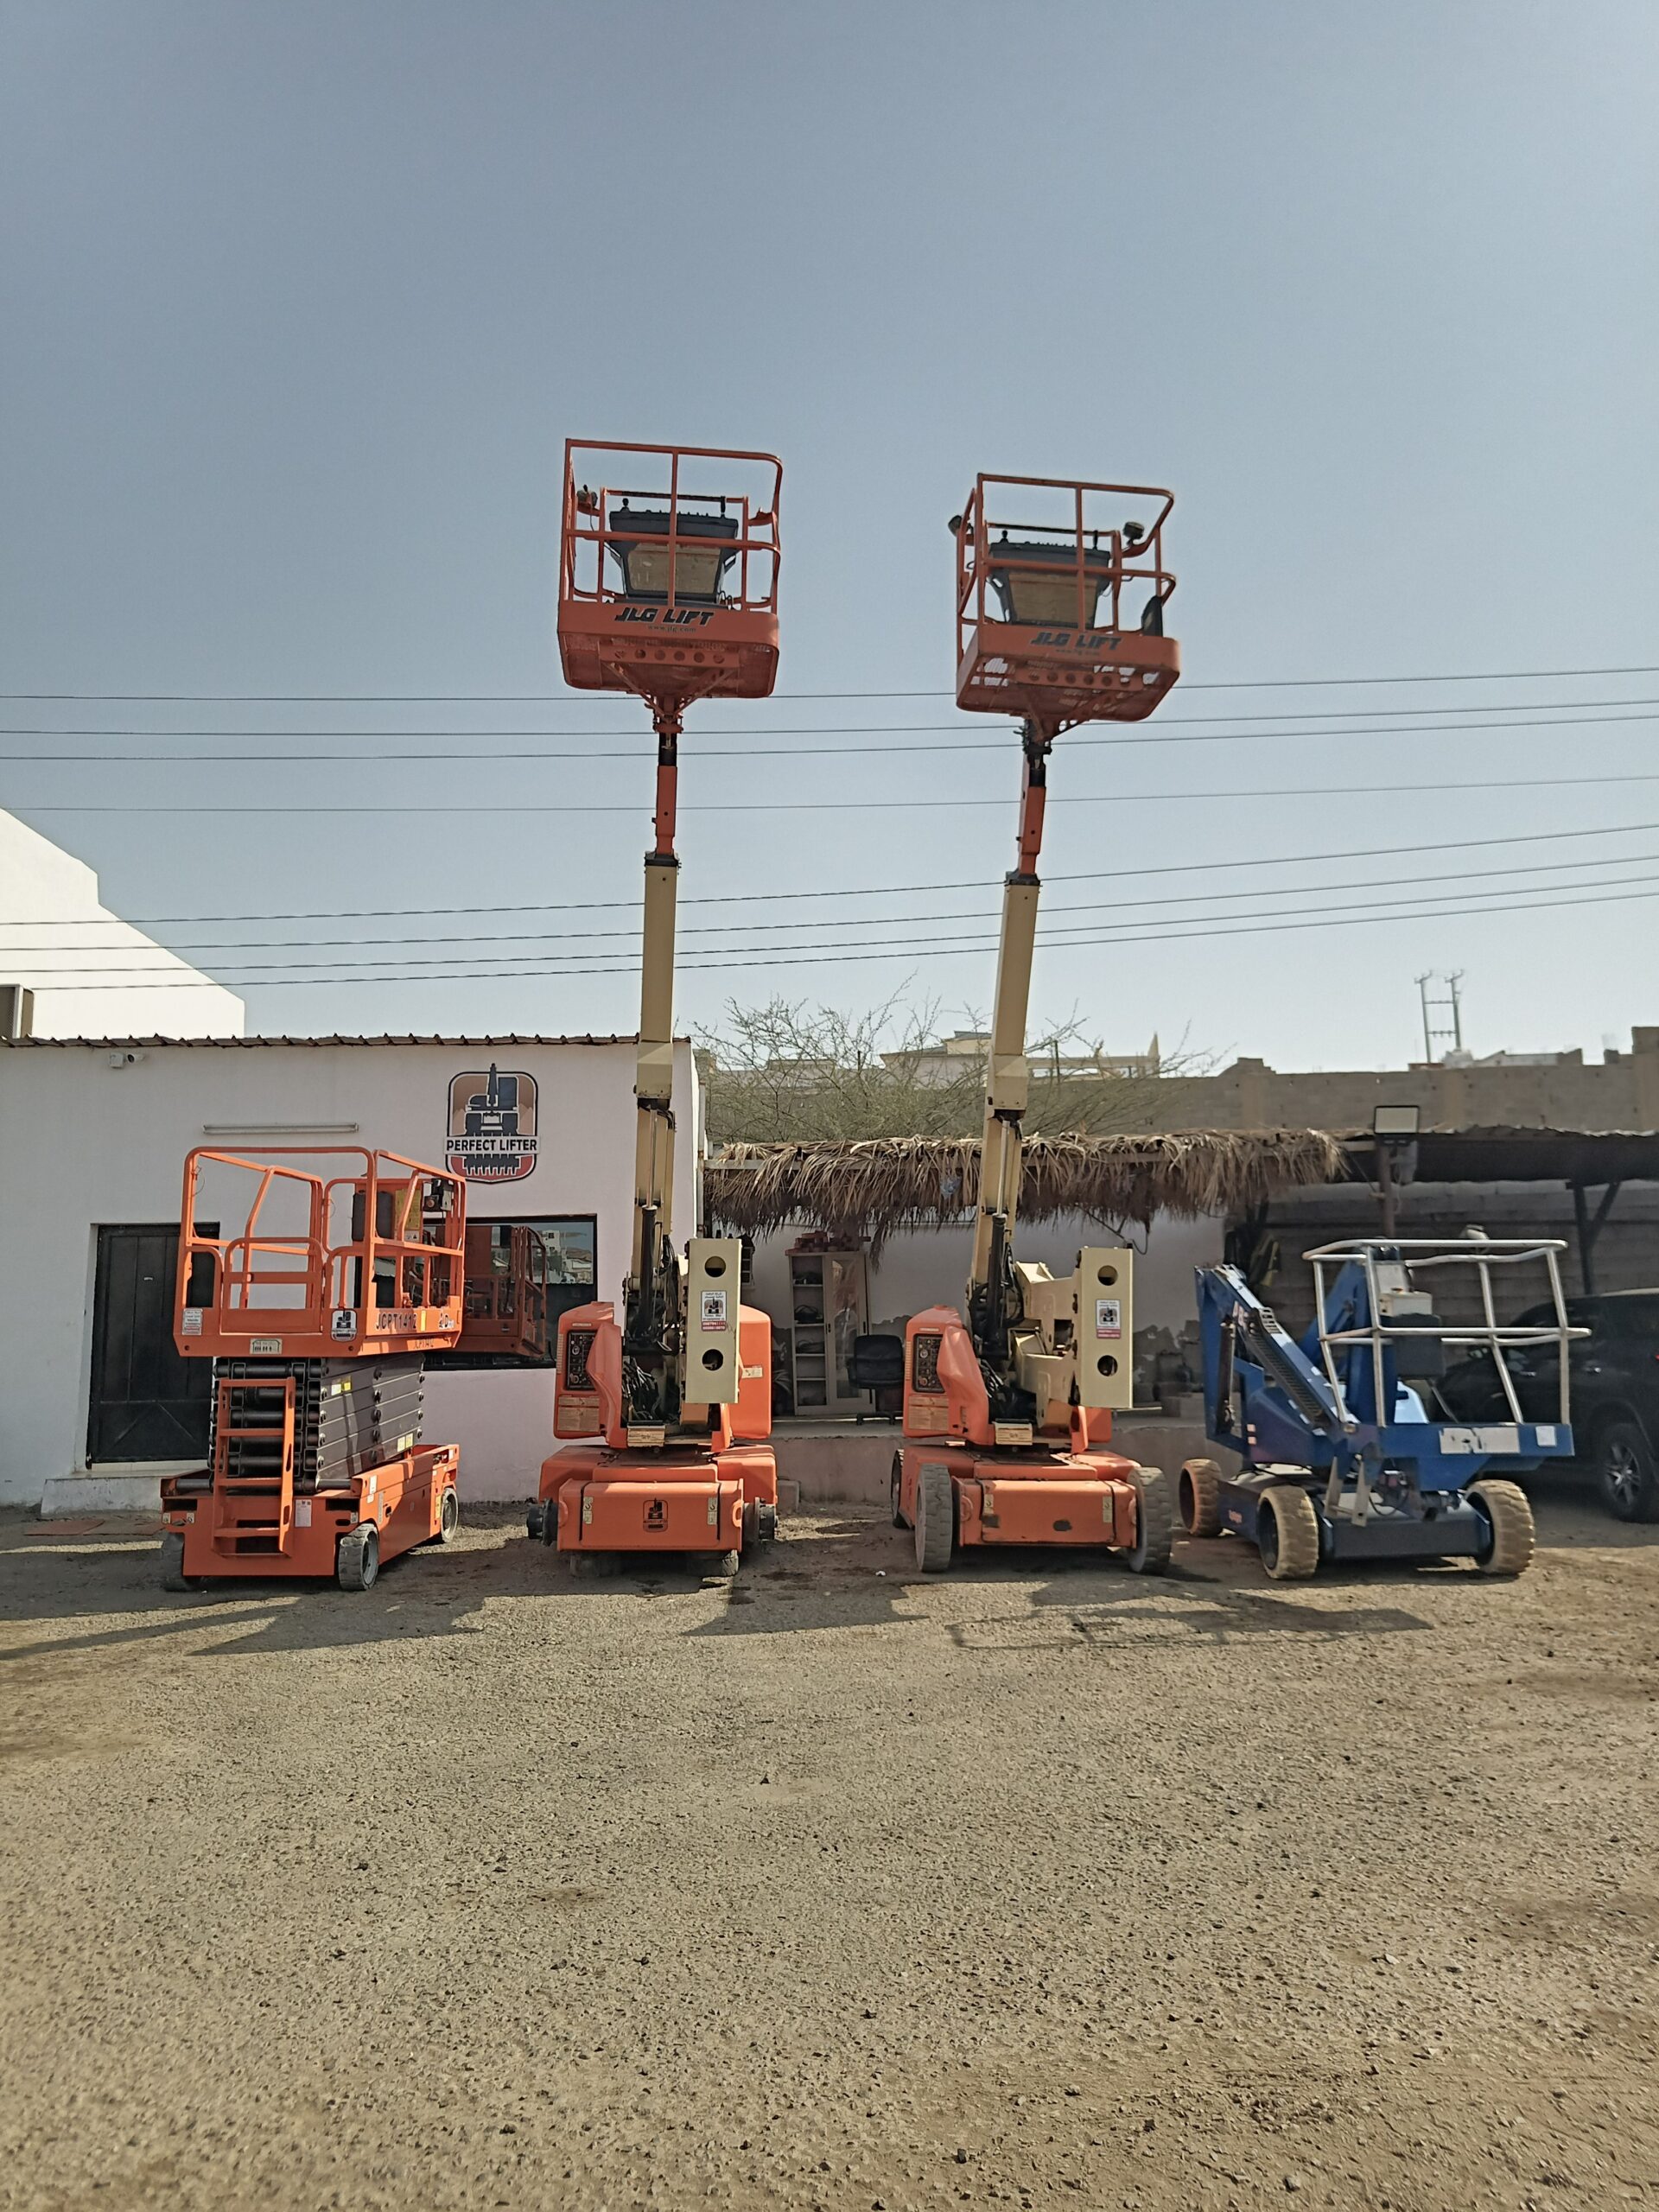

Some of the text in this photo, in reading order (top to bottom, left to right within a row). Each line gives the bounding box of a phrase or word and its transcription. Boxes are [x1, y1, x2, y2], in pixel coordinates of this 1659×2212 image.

[614, 607, 715, 626] JLG LIFT
[1030, 631, 1122, 651] JLG LIFT
[446, 1139, 537, 1152] PERFECT LIFTER
[375, 1313, 416, 1330] JCPT1412
